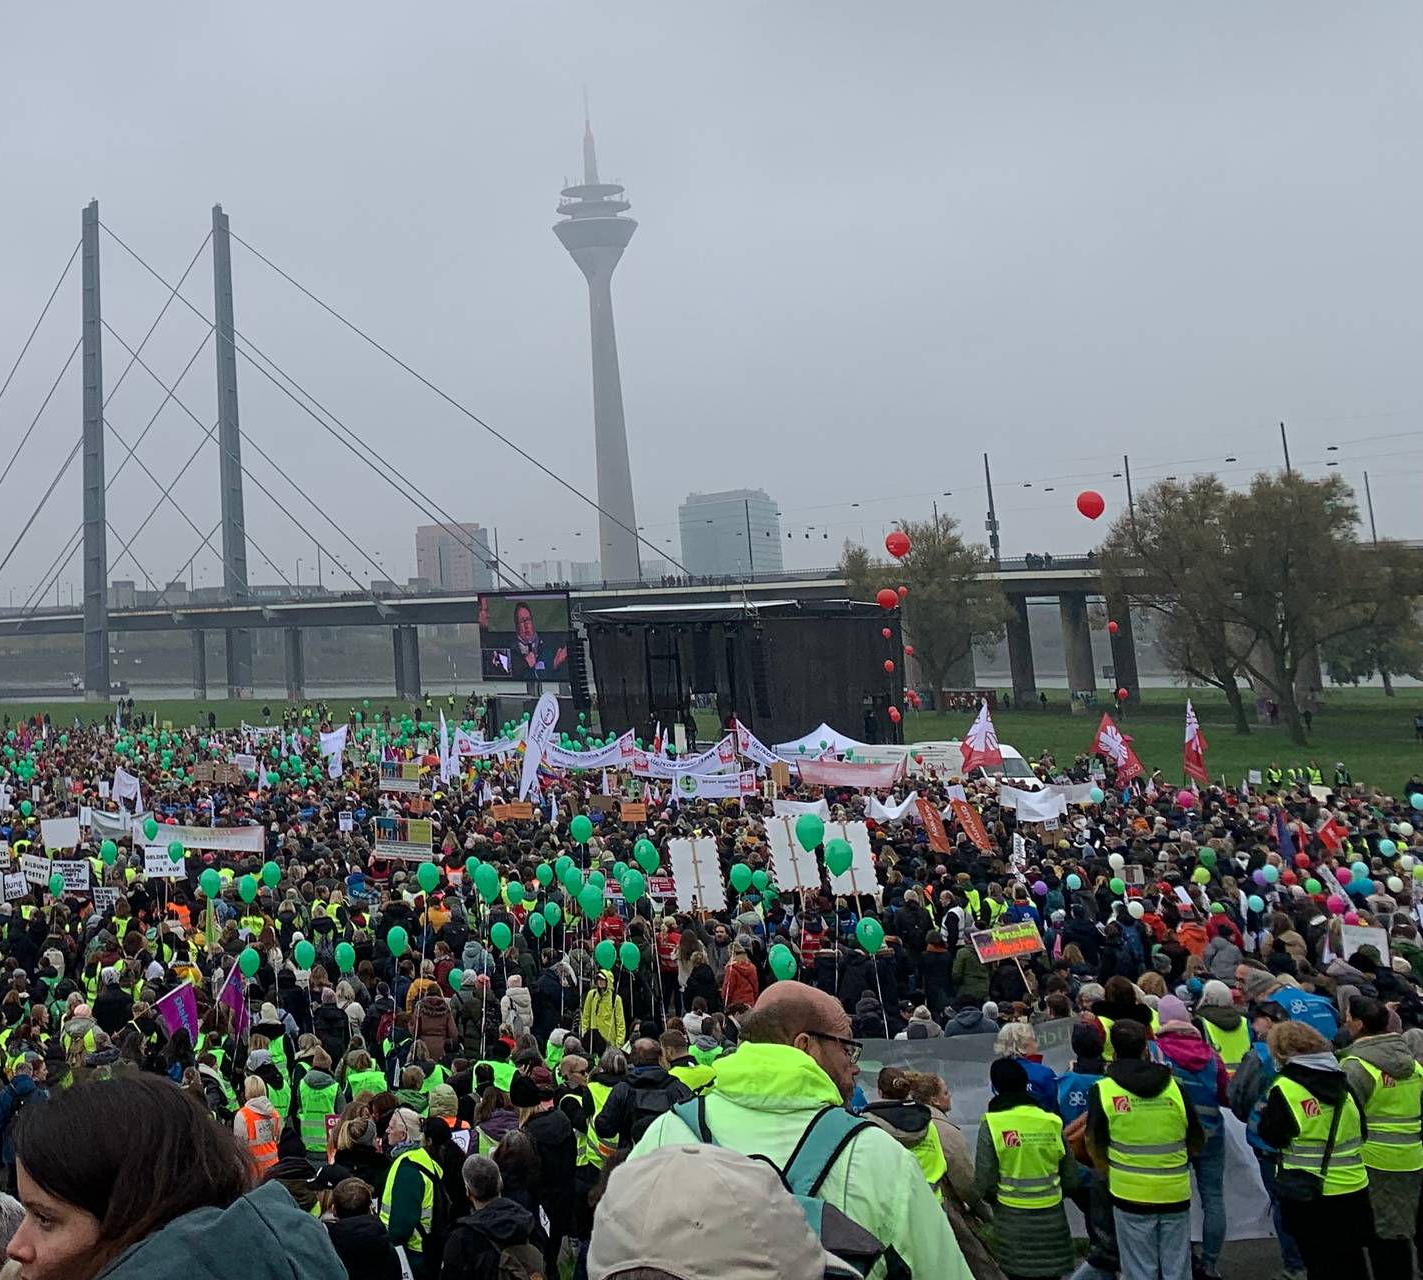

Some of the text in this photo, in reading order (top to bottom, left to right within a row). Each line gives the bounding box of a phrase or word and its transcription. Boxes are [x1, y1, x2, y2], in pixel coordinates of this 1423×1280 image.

[961, 806, 984, 844] anyway
[25, 861, 49, 870] BILDUNG
[5, 880, 23, 890] dung
[5, 889, 24, 898] stet!
